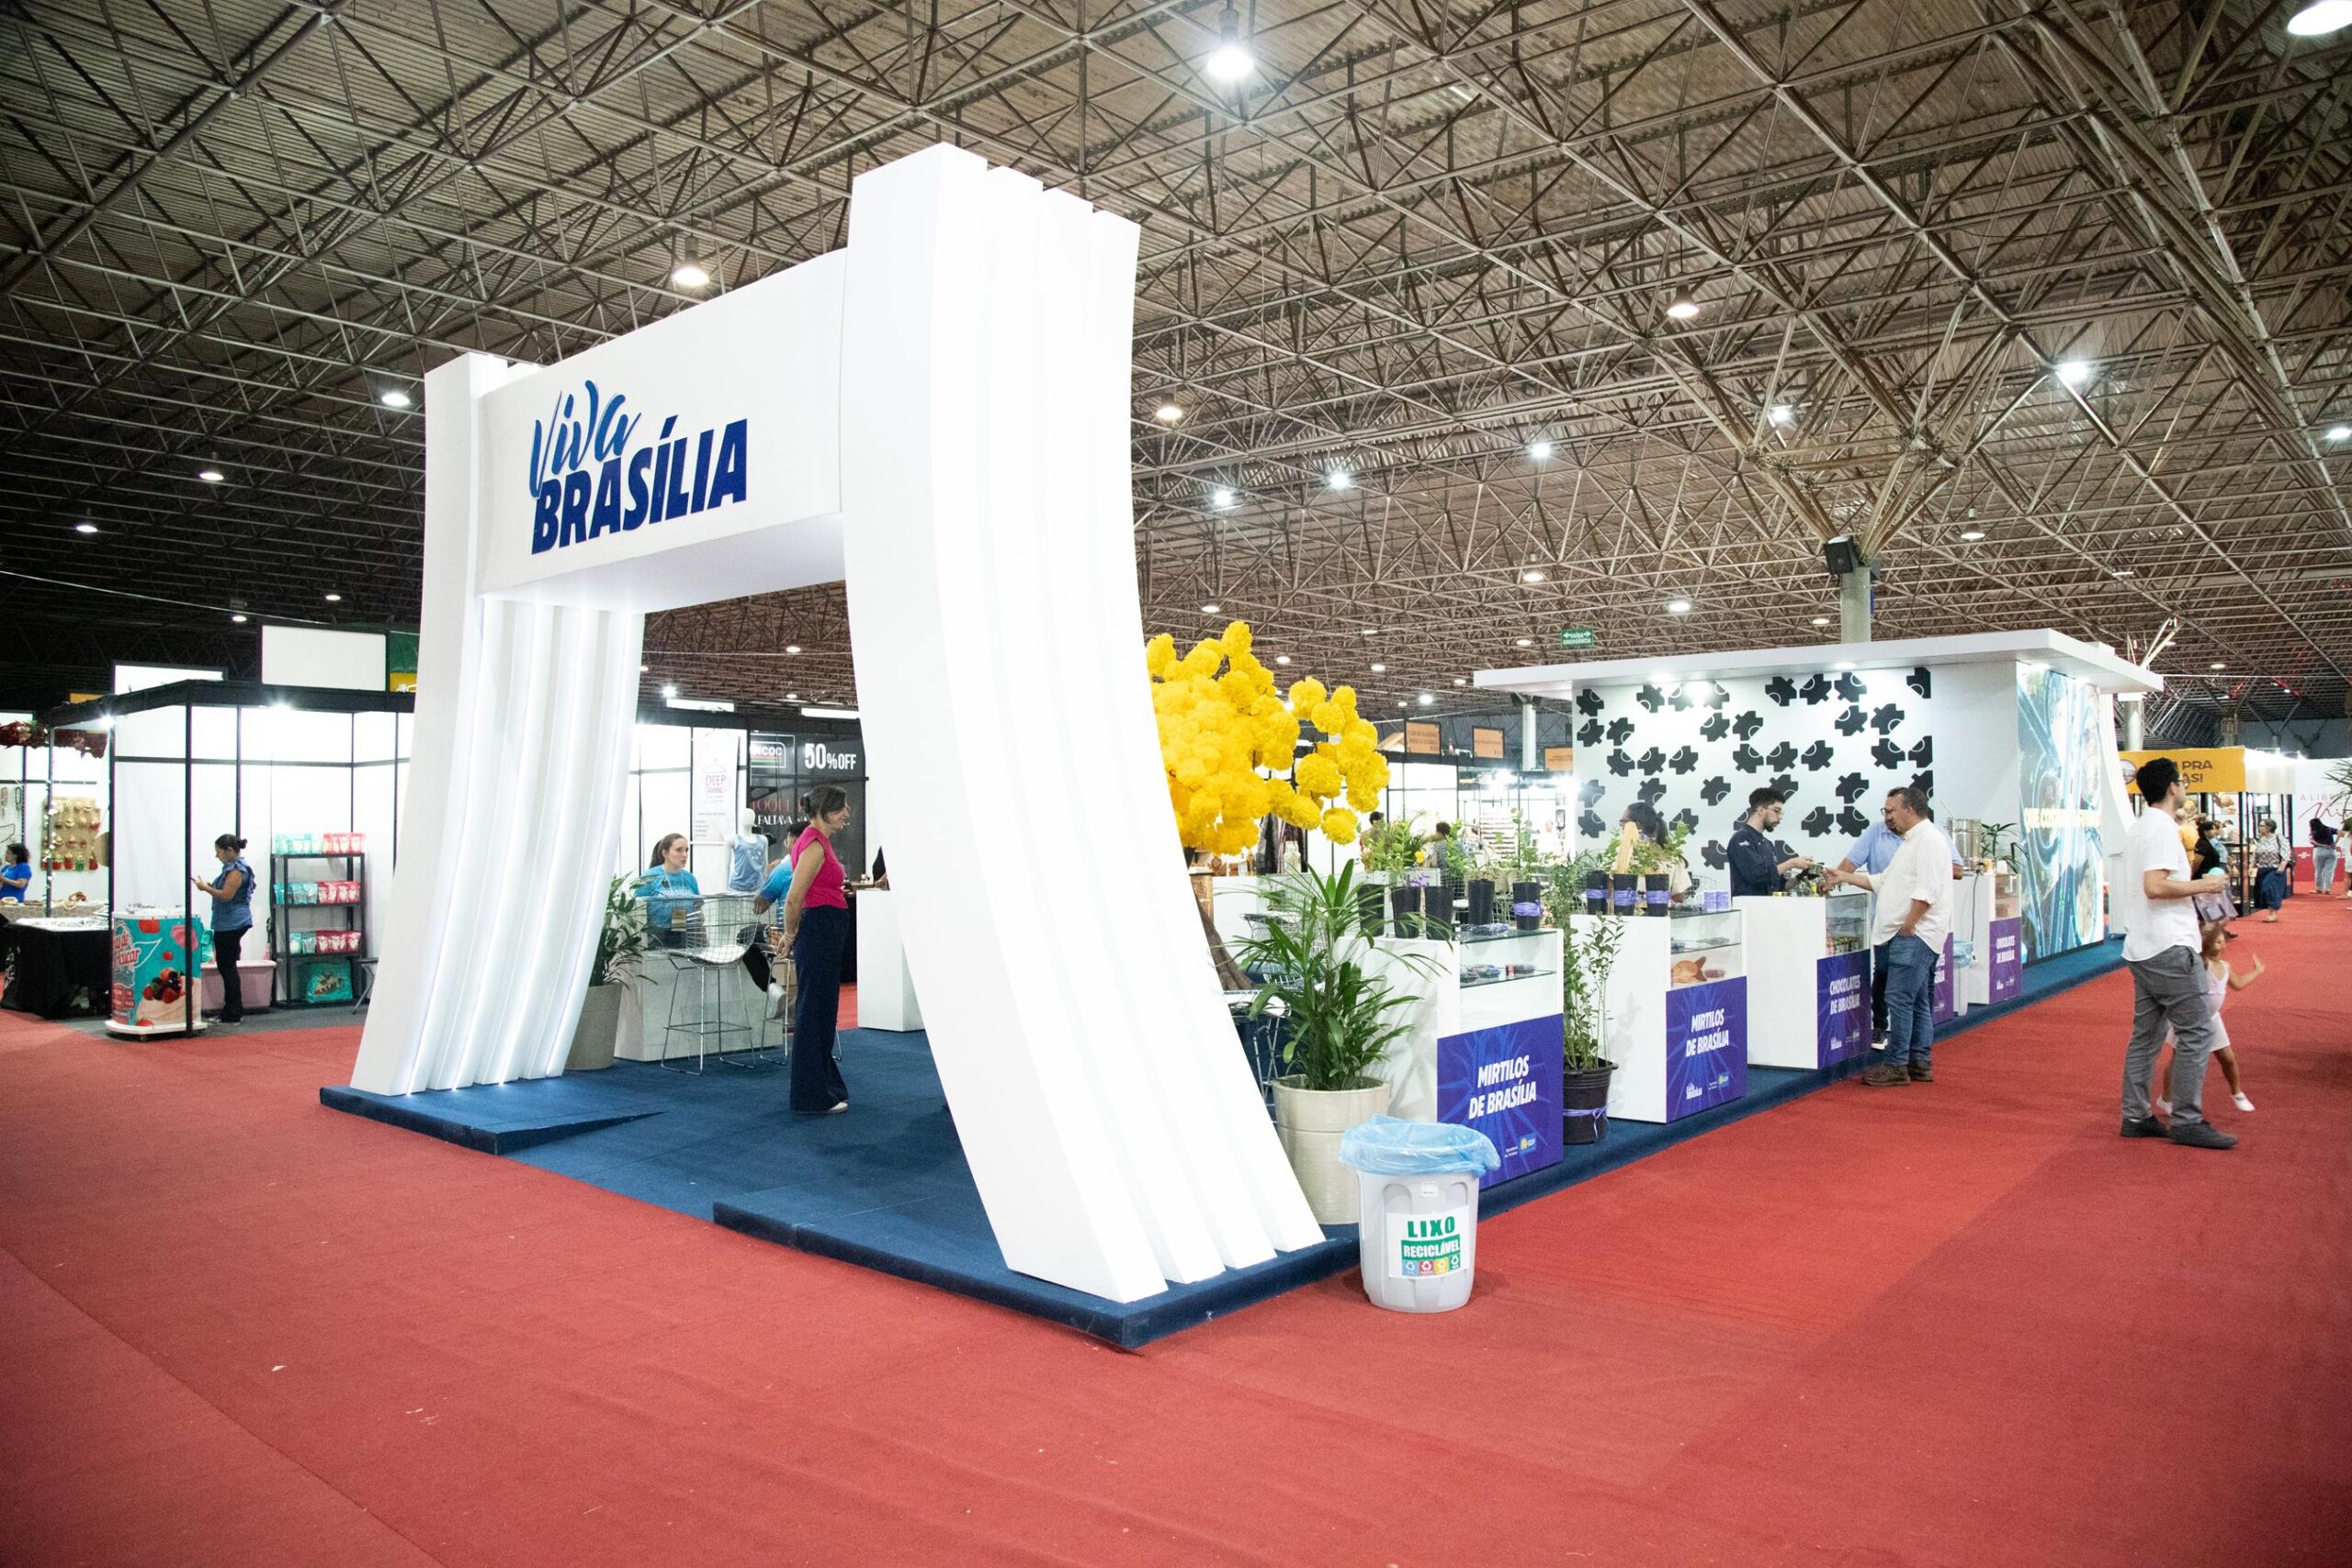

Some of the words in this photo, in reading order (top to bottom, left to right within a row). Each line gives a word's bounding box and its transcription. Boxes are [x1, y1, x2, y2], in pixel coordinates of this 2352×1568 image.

[529, 379, 641, 499] Viva
[531, 414, 748, 555] BRASÍLIA
[2182, 761, 2212, 771] PRA
[1829, 974, 1860, 996] CHOCOLATES
[1829, 998, 1838, 1015] DE
[1838, 991, 1860, 1012] BRASÍLIA
[1690, 1008, 1724, 1032] MIRTILOS
[1685, 1038, 1696, 1057] DE
[1697, 1027, 1729, 1055] BRASÍLIA
[1477, 1055, 1530, 1089] MIRTILOS
[1468, 1095, 1486, 1120] DE
[1487, 1079, 1537, 1114] BRASÍLIA
[1408, 1216, 1455, 1238] LIXO
